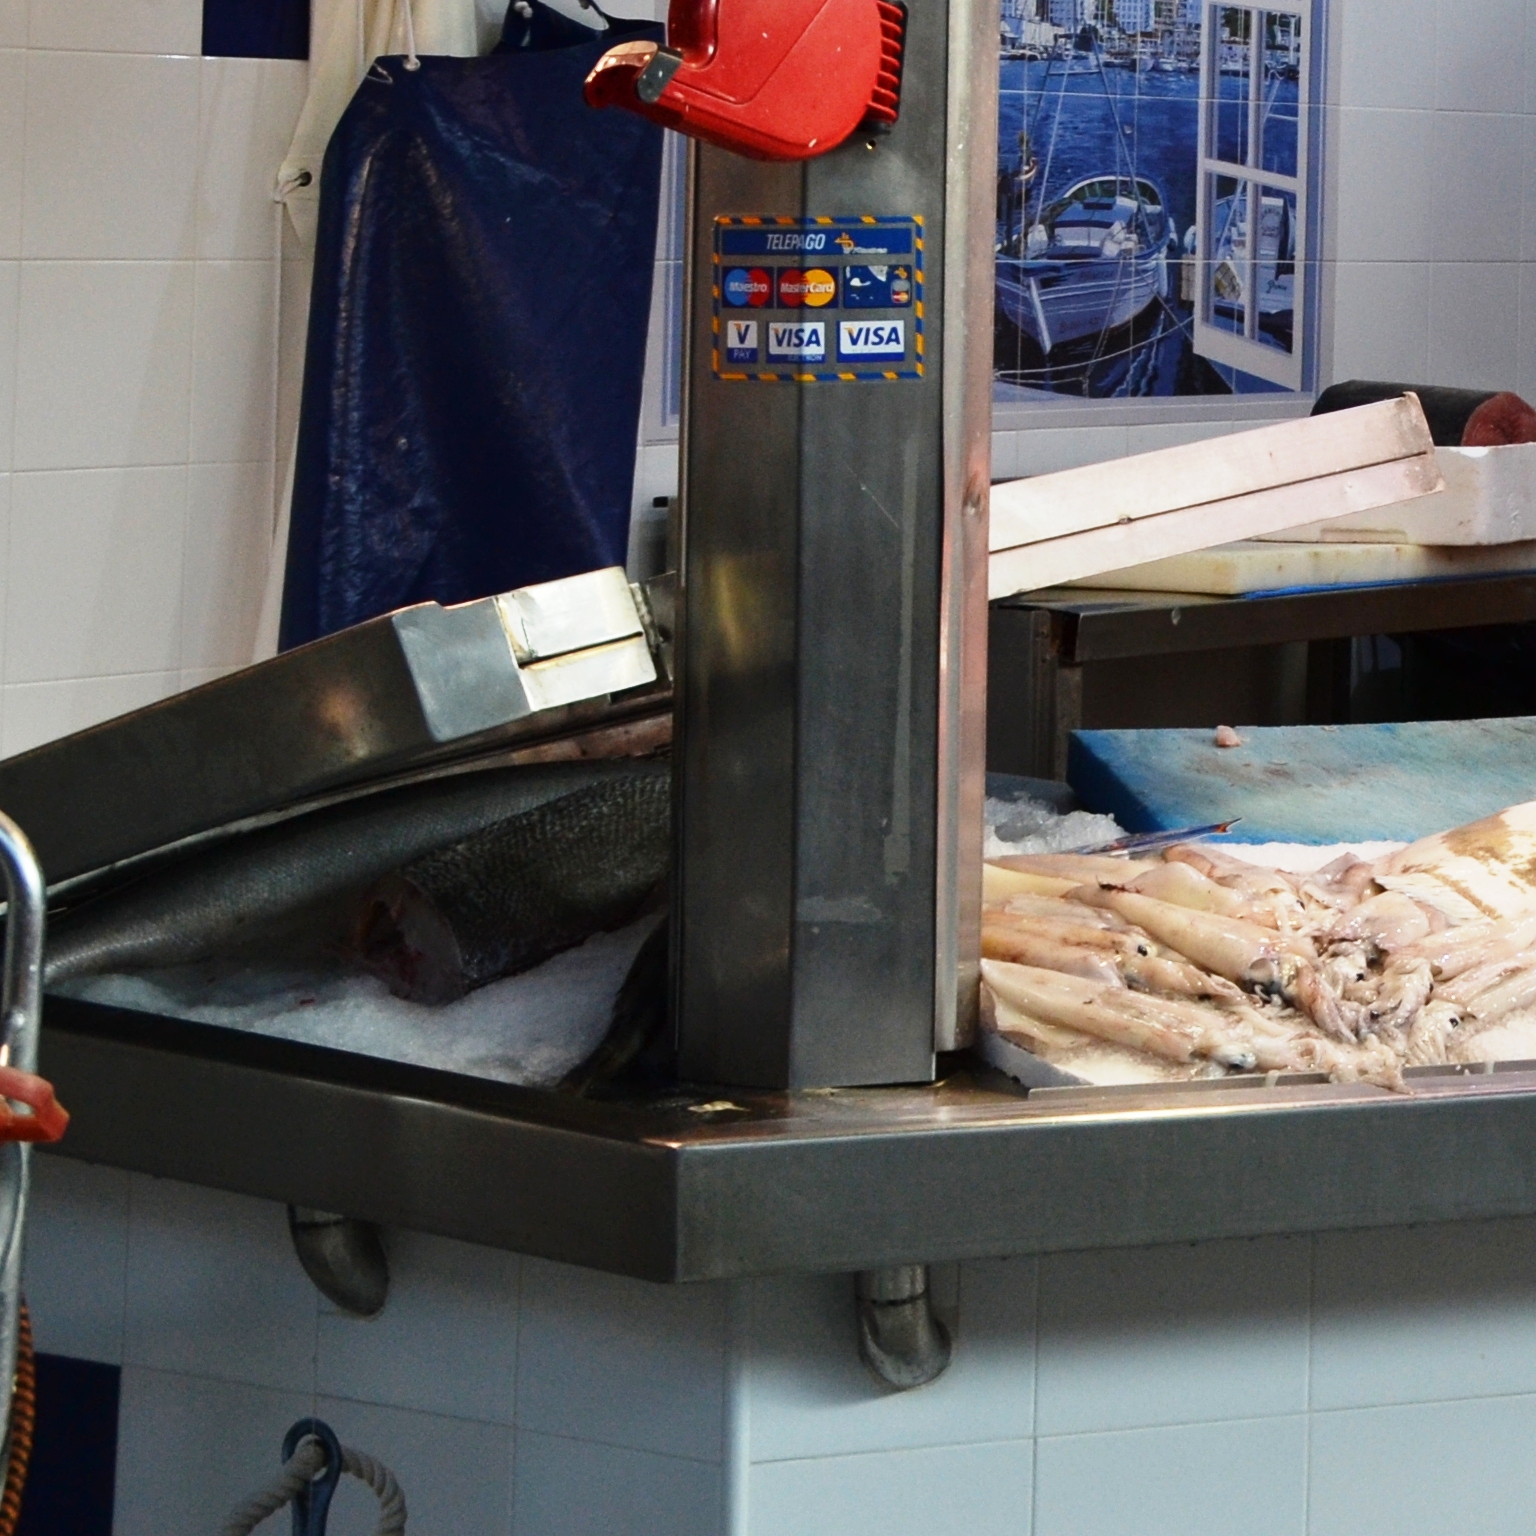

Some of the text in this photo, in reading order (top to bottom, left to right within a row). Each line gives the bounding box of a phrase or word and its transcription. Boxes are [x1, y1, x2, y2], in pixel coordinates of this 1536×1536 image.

[766, 233, 825, 250] TELEPAGO
[729, 280, 835, 293] Maestro MasterCard
[772, 327, 821, 348] VISA
[844, 326, 901, 346] VISA
[733, 349, 750, 359] PAY
